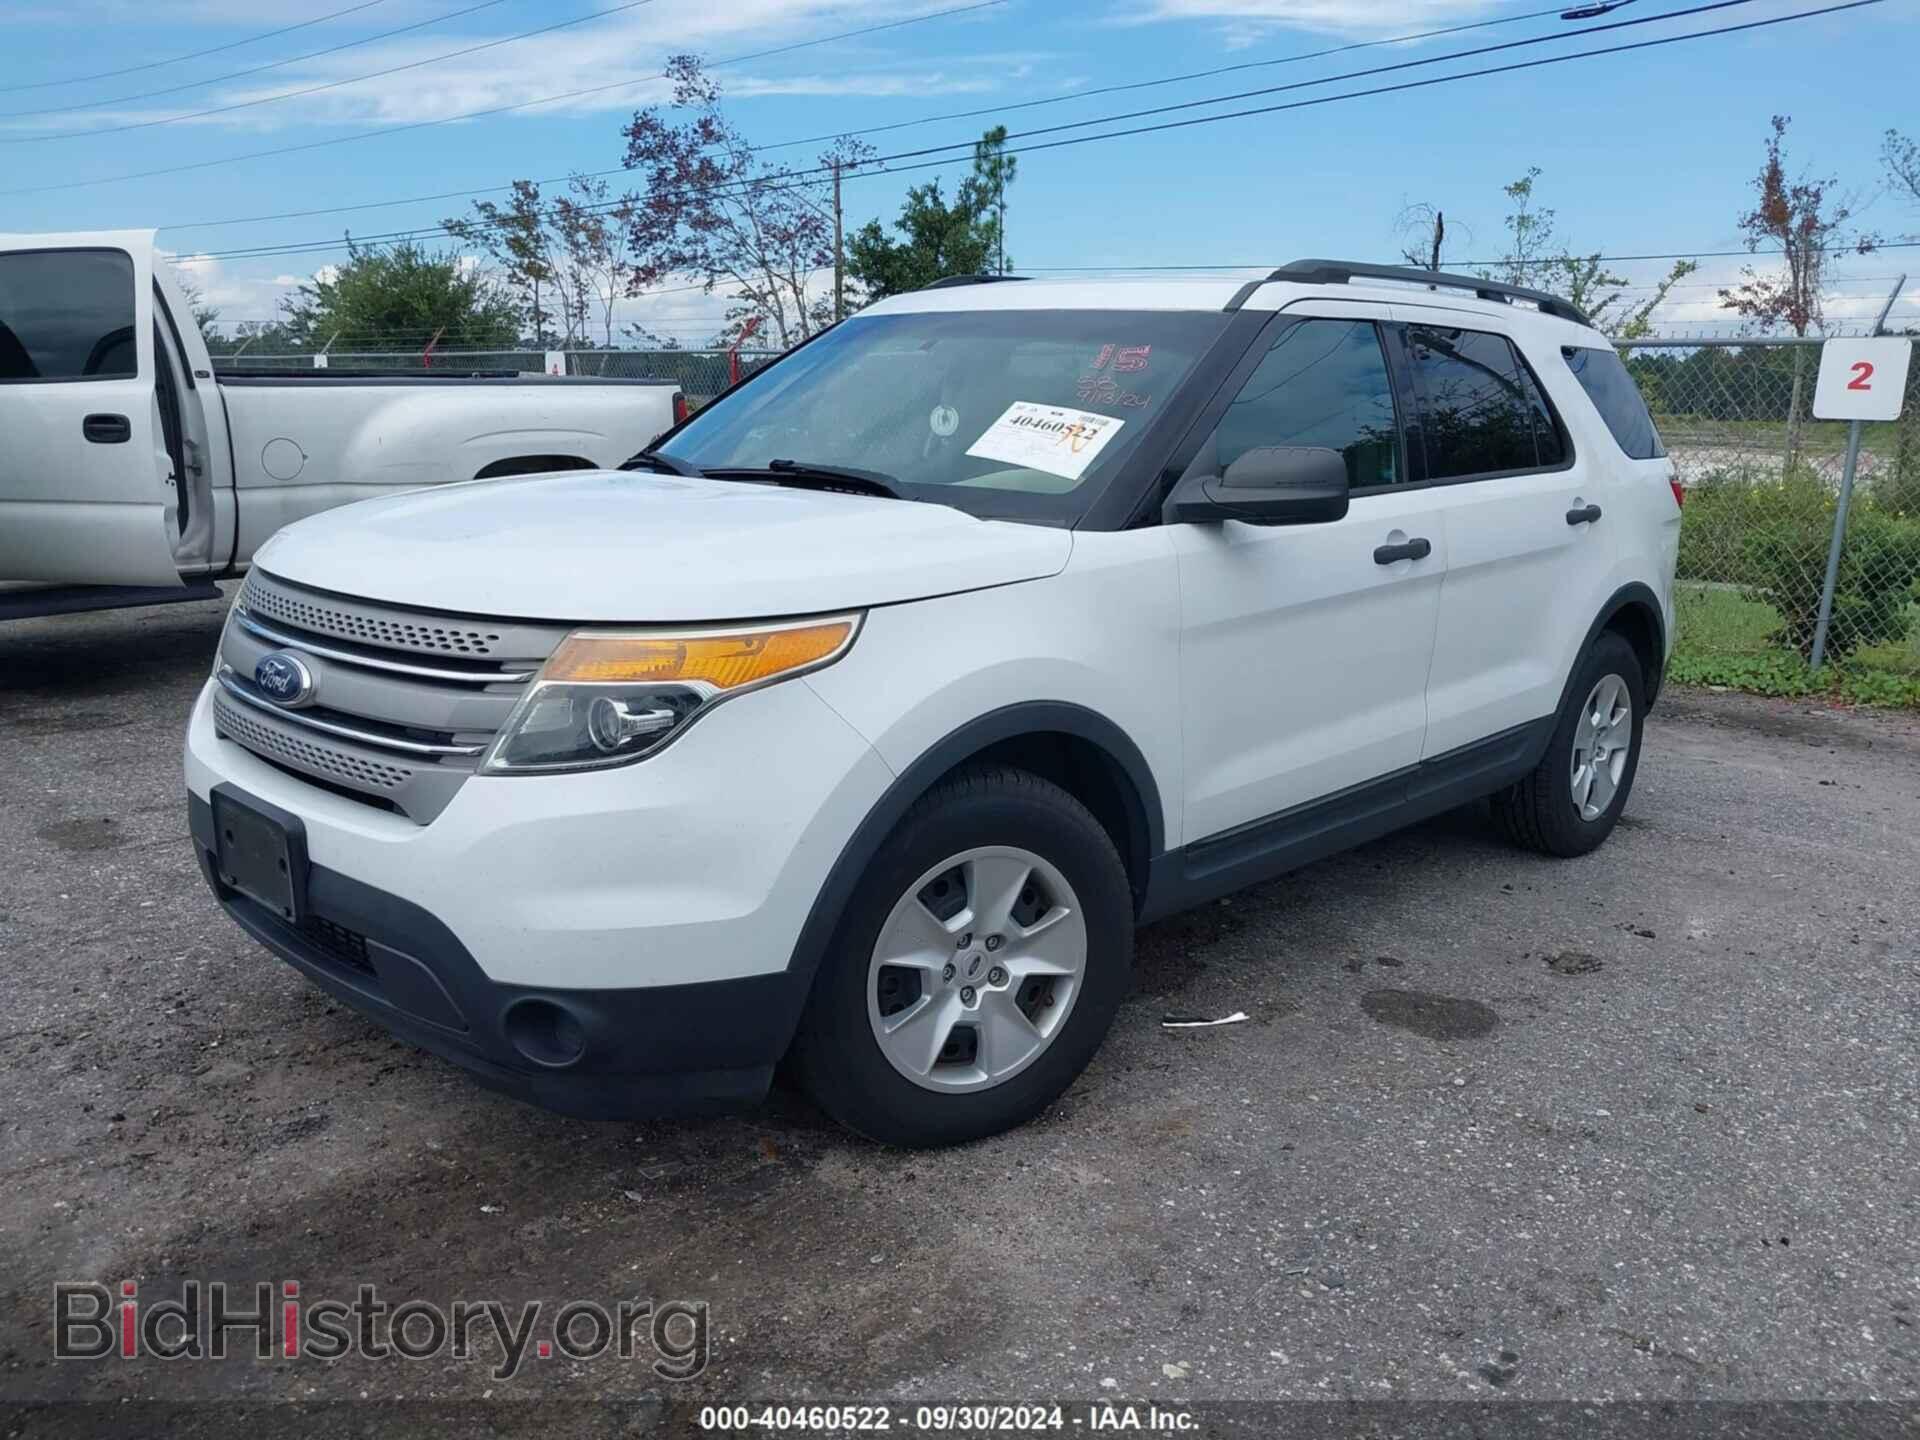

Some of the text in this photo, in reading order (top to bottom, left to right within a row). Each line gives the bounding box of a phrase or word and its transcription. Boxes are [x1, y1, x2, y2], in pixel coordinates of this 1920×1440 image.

[1093, 343, 1152, 372] 15
[1847, 361, 1874, 390] 2
[1010, 415, 1098, 440] 40460522
[260, 660, 292, 693] Ford
